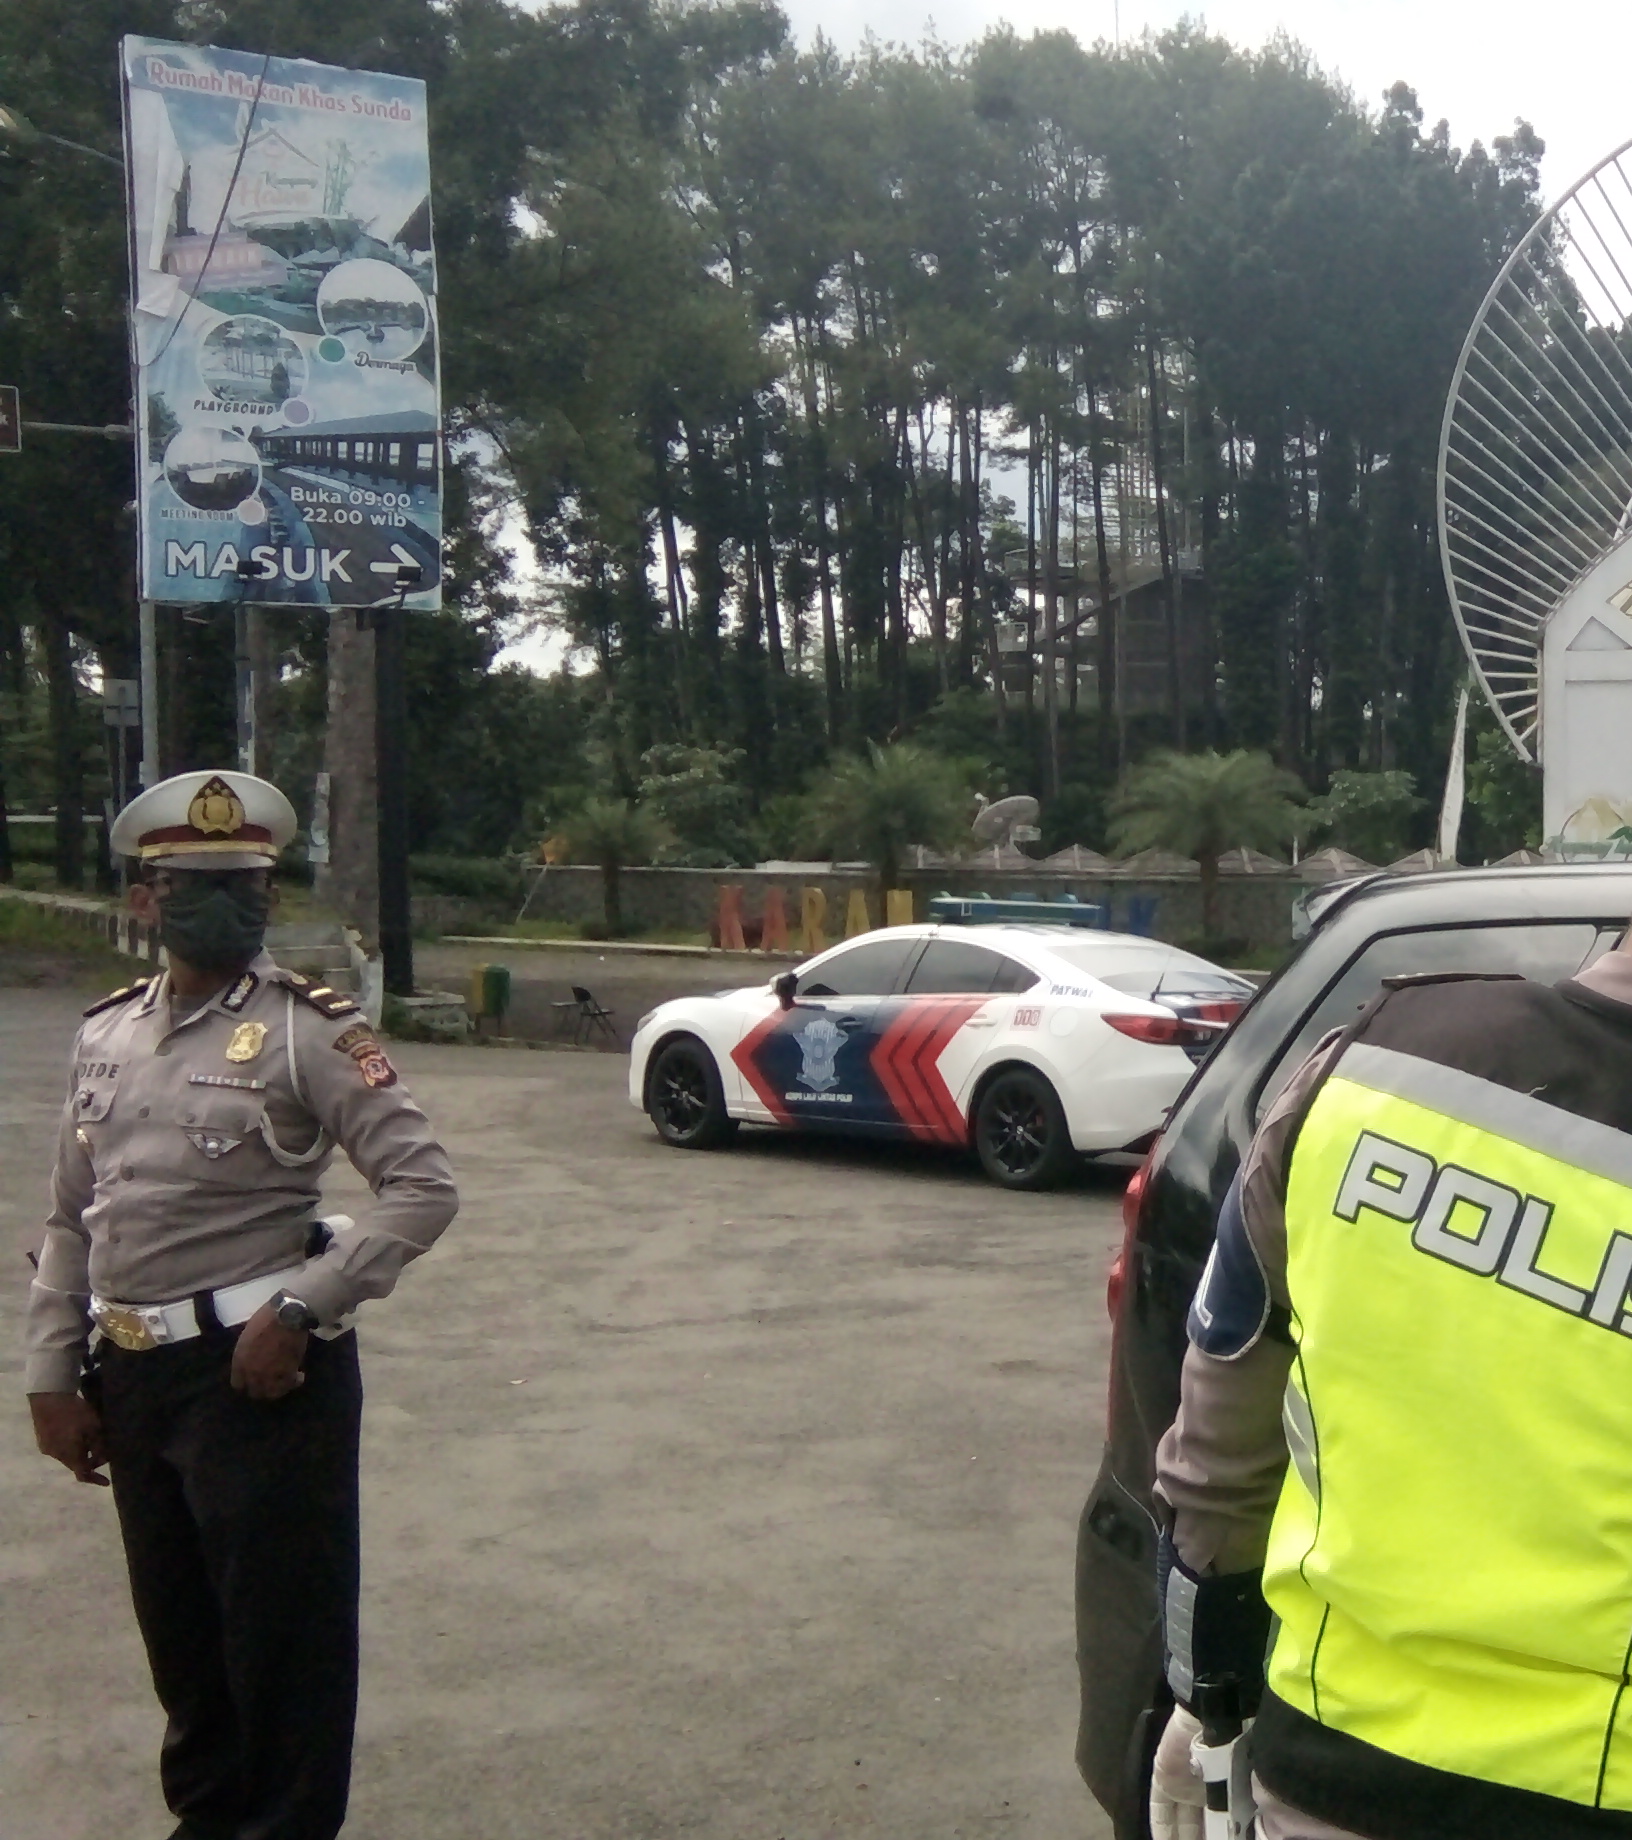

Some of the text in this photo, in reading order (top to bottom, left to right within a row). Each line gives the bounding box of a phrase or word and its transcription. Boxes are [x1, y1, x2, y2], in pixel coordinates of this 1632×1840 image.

[150, 61, 412, 121] Rumah Makan Khas Sunda
[193, 400, 274, 416] PLAYGROUND
[290, 485, 343, 504] Buka
[302, 506, 407, 528] 22.00 wib
[164, 538, 353, 583] MASUK
